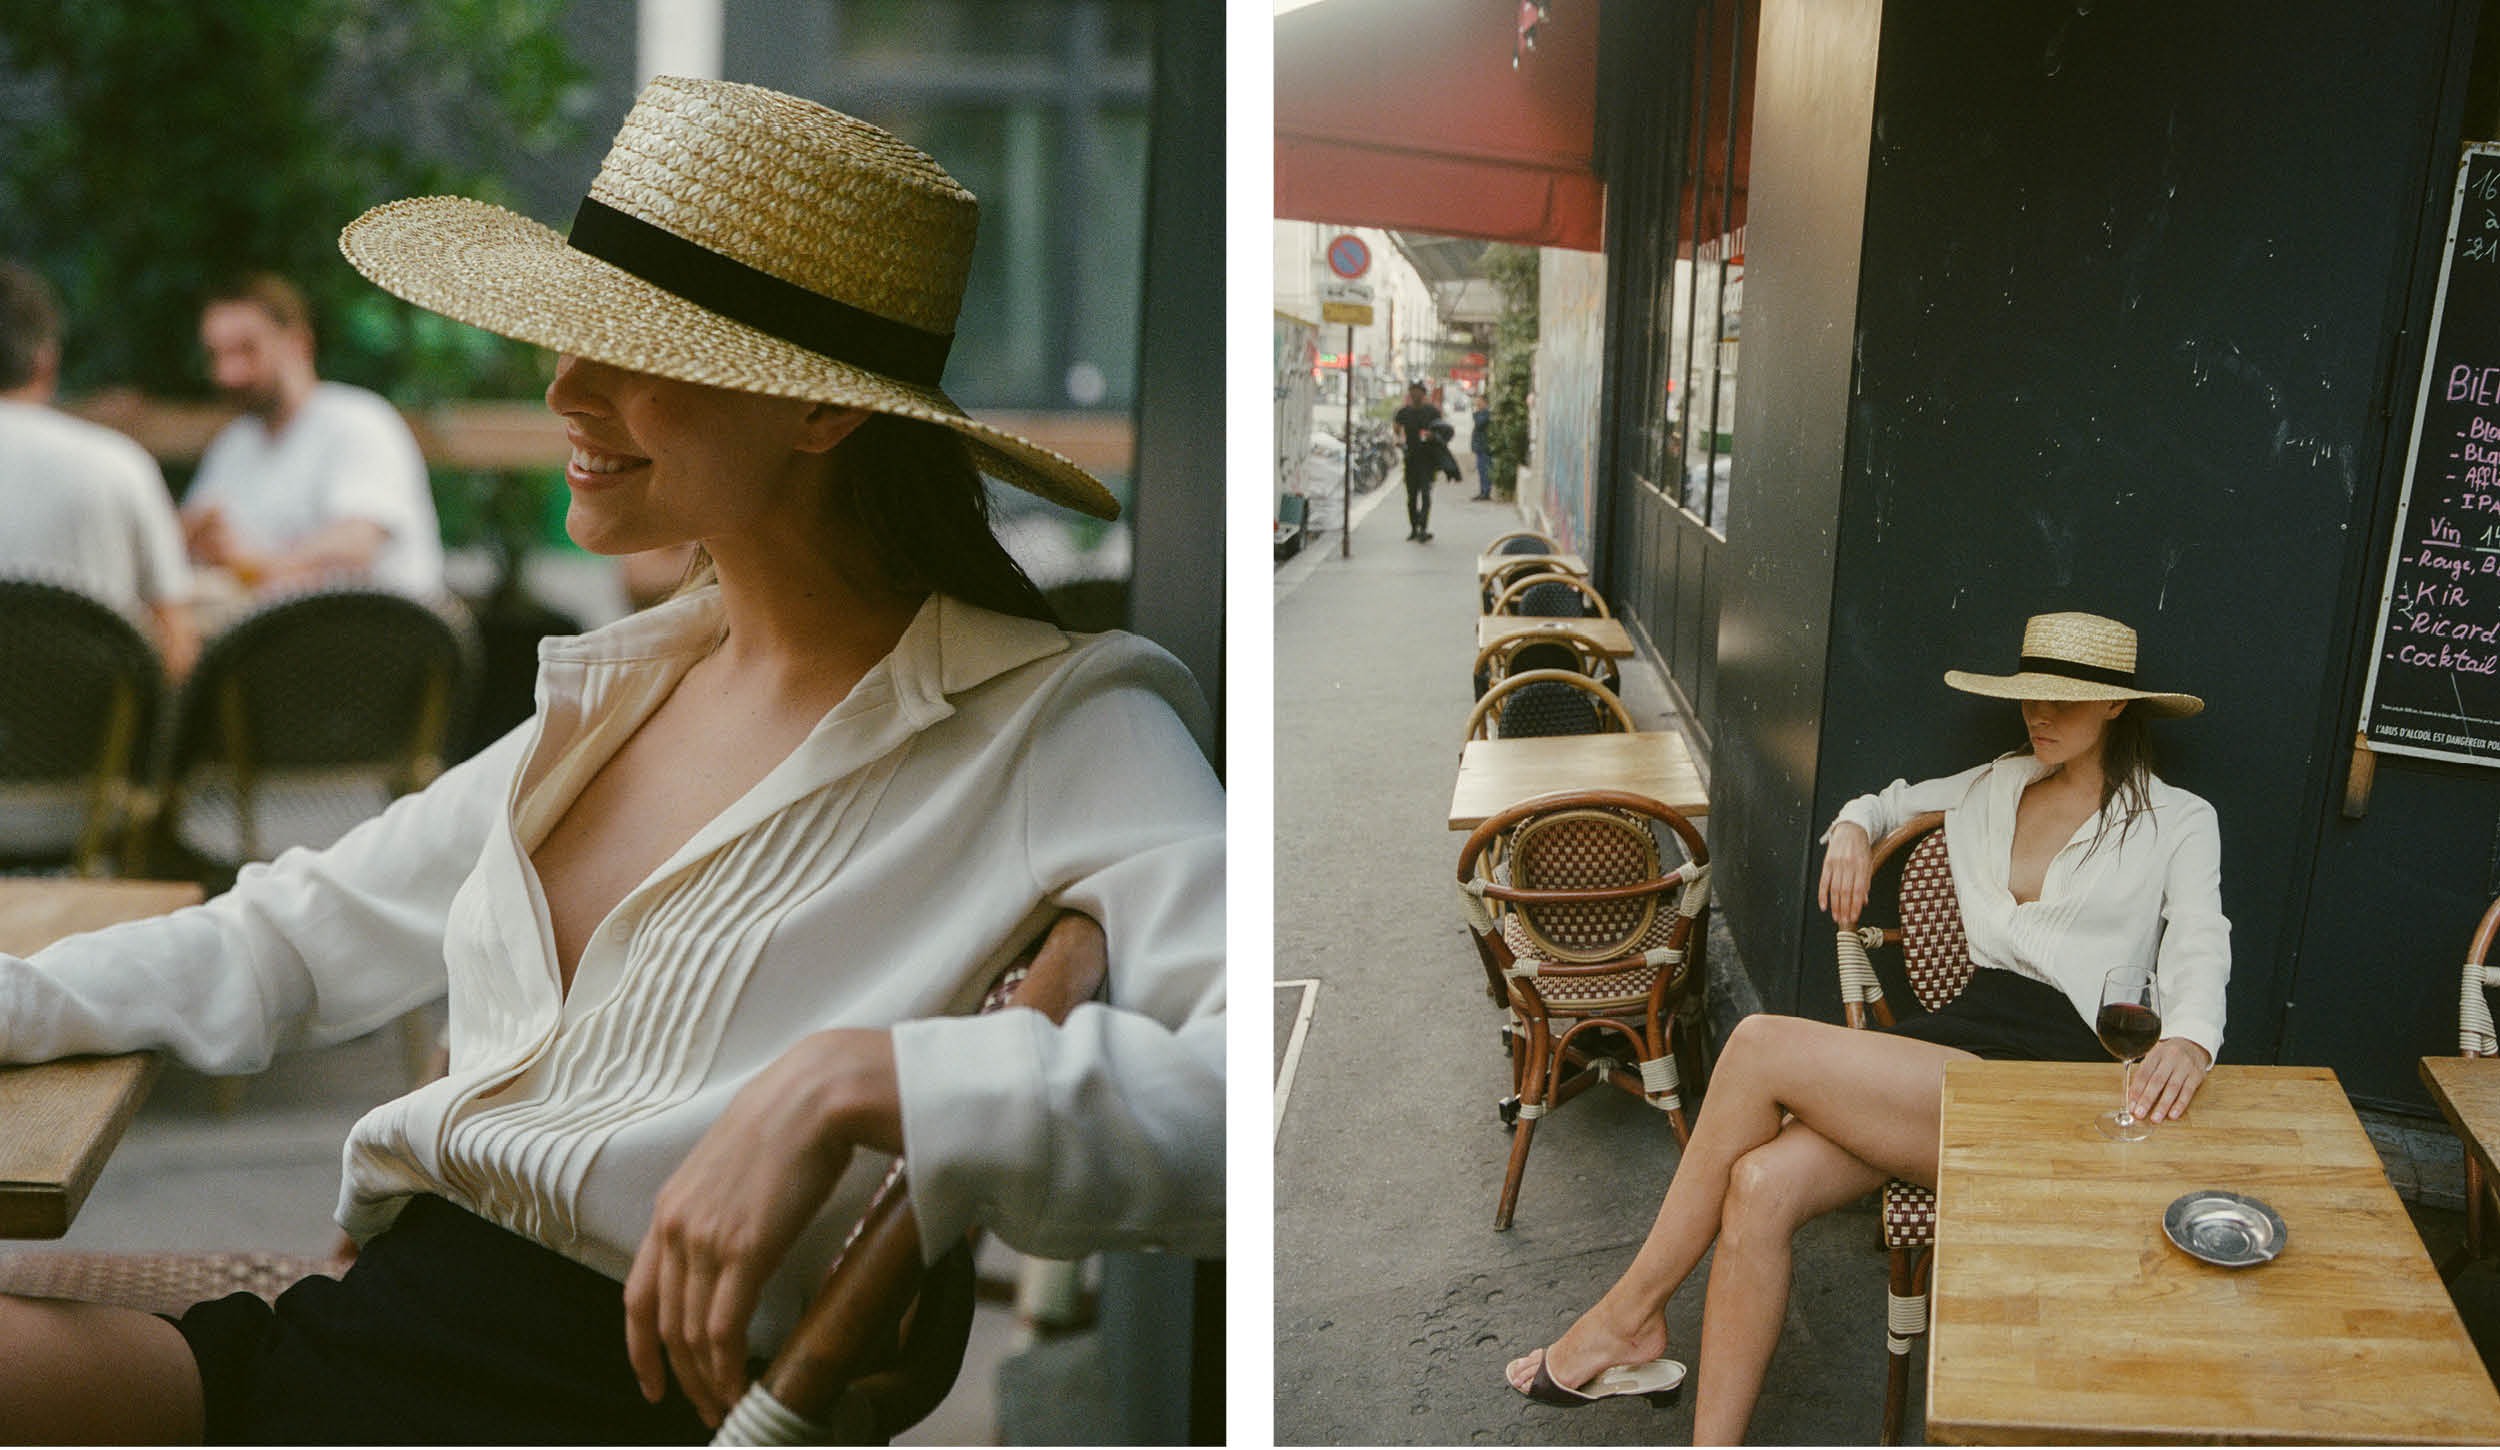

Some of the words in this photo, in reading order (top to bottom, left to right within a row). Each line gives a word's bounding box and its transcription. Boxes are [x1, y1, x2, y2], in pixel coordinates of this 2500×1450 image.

[2447, 364, 2500, 406] BiE
[2430, 516, 2461, 544] Vin
[2410, 612, 2500, 644] Ricard
[2399, 728, 2432, 741] D'ALCOOL
[2432, 732, 2446, 743] EST
